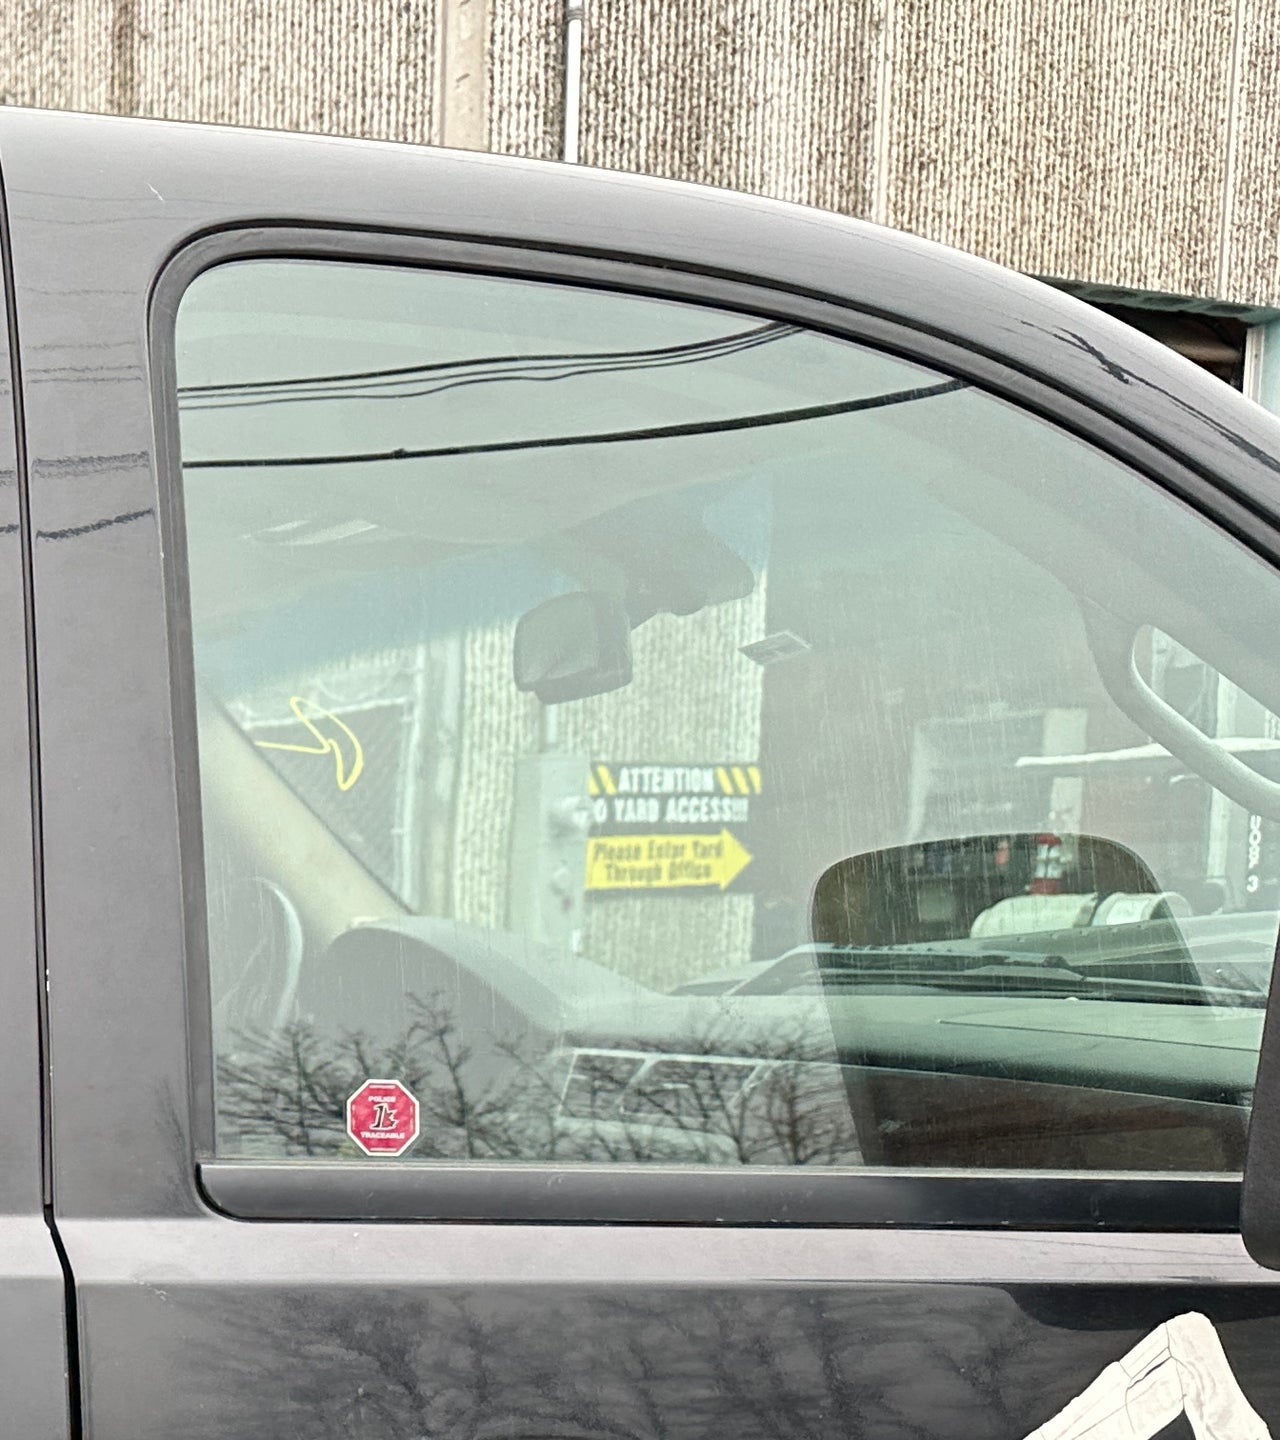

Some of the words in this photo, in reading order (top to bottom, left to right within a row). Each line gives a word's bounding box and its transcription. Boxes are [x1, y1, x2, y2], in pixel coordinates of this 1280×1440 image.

[617, 766, 715, 793] ATTENTION
[614, 797, 660, 823] YARD
[593, 841, 642, 862] Please
[648, 839, 686, 860] Enter
[692, 838, 723, 859] Yard
[605, 861, 662, 885] Through
[669, 860, 712, 881] Office
[368, 1095, 397, 1103] POLICE
[360, 1131, 406, 1139] TRACEABLE
